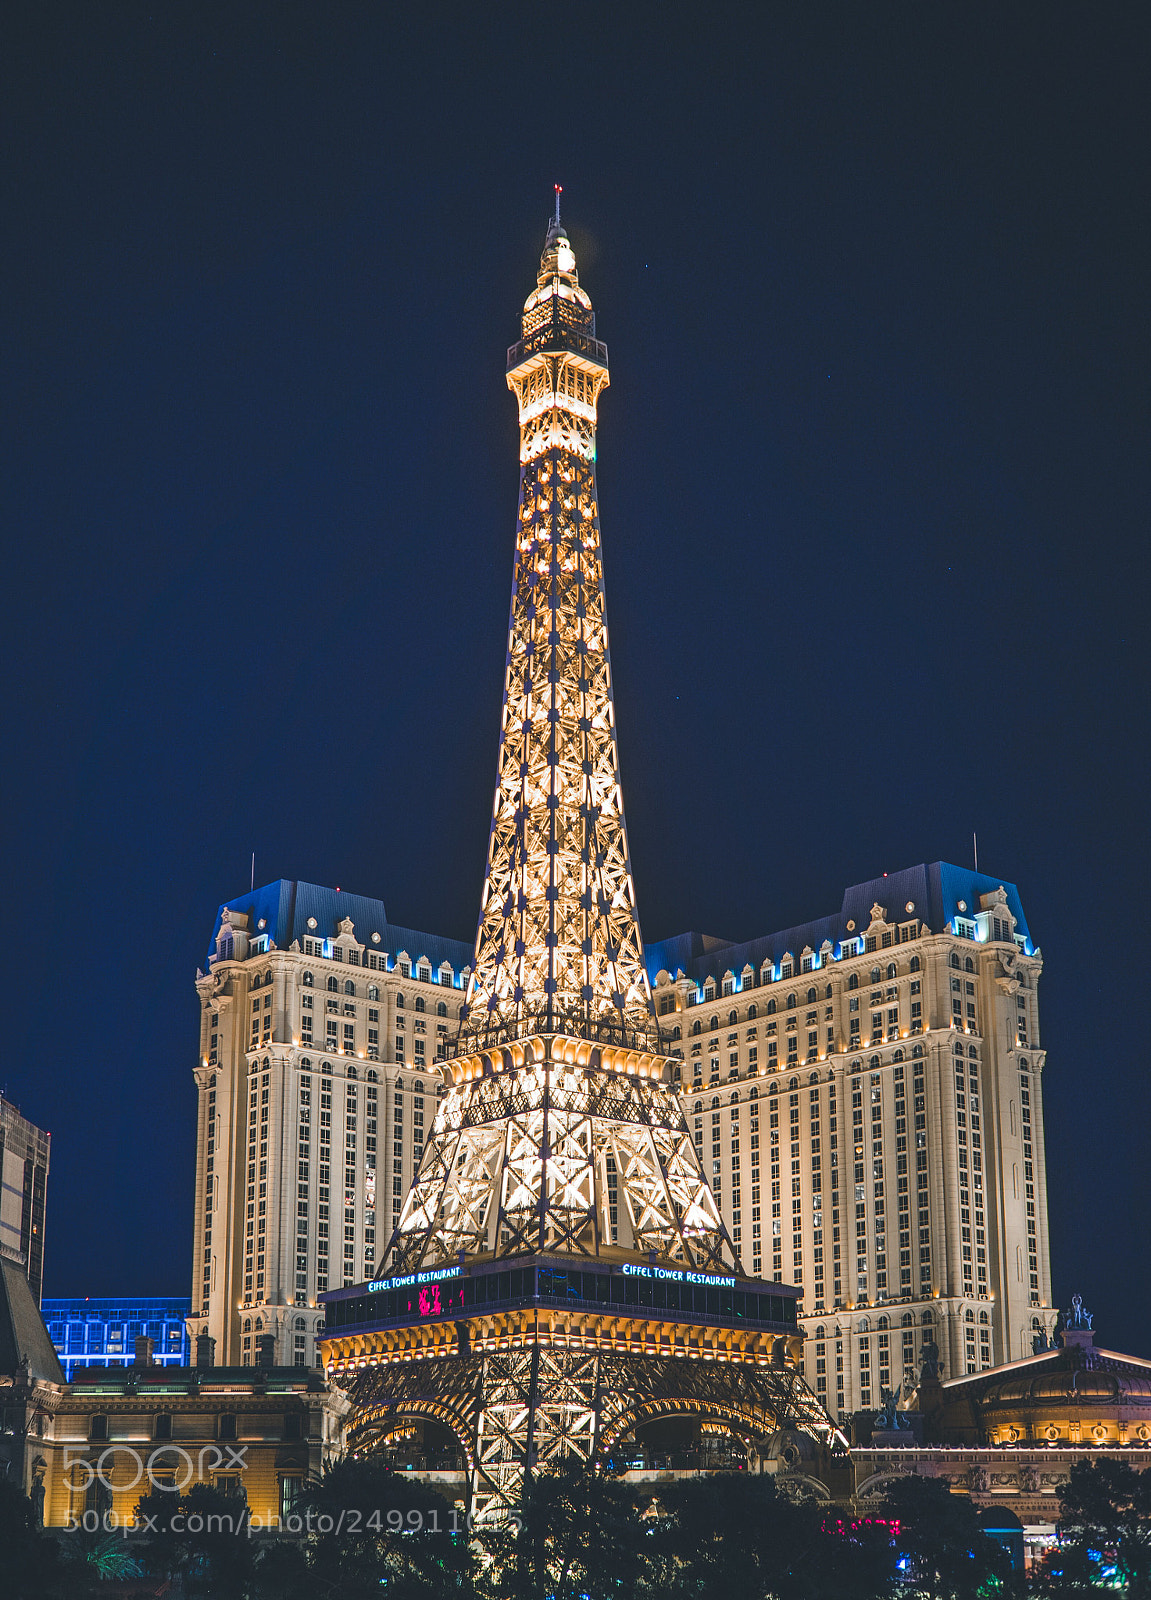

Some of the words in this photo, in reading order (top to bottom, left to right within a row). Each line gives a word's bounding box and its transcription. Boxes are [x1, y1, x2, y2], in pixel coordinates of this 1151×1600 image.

[368, 1279, 391, 1293] EIFFEL
[391, 1274, 416, 1289] TOWER
[417, 1266, 461, 1283] RESTAURANT
[622, 1263, 652, 1278] EIFFEL
[653, 1267, 683, 1281] TOWER
[686, 1271, 736, 1288] RESTAURANT
